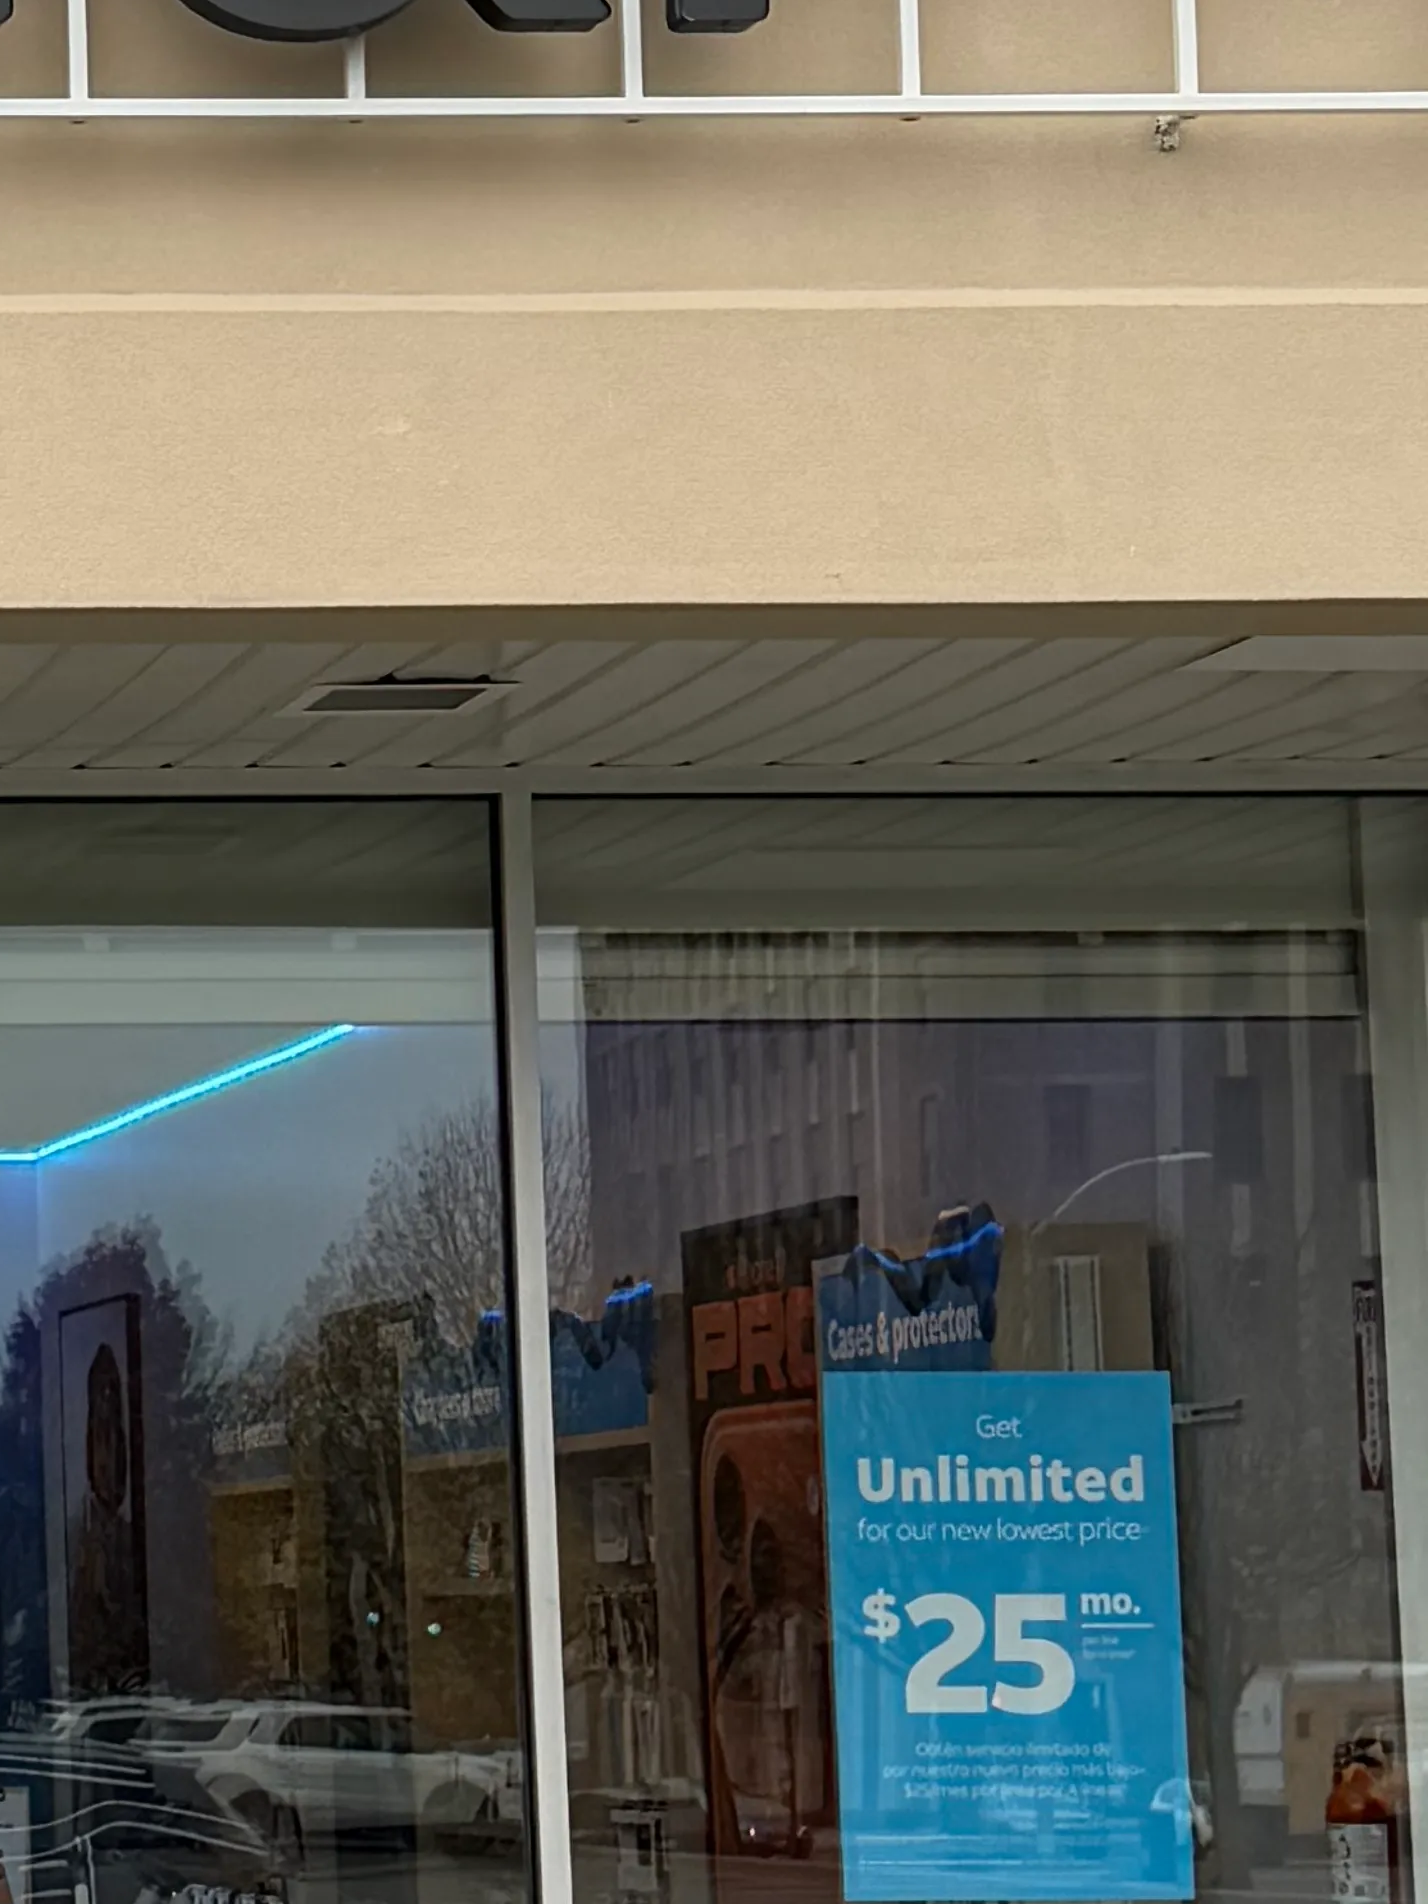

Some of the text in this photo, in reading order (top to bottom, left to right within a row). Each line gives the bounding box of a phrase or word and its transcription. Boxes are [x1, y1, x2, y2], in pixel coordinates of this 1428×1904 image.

[827, 1319, 873, 1361] Cases
[875, 1312, 888, 1353] &
[976, 1414, 1022, 1439] Get
[857, 1454, 1144, 1503] Unlimited
[857, 1517, 891, 1542] for
[896, 1521, 936, 1542] our
[942, 1521, 992, 1542] new
[997, 1517, 1073, 1542] lowest
[1080, 1592, 1141, 1615] mo.
